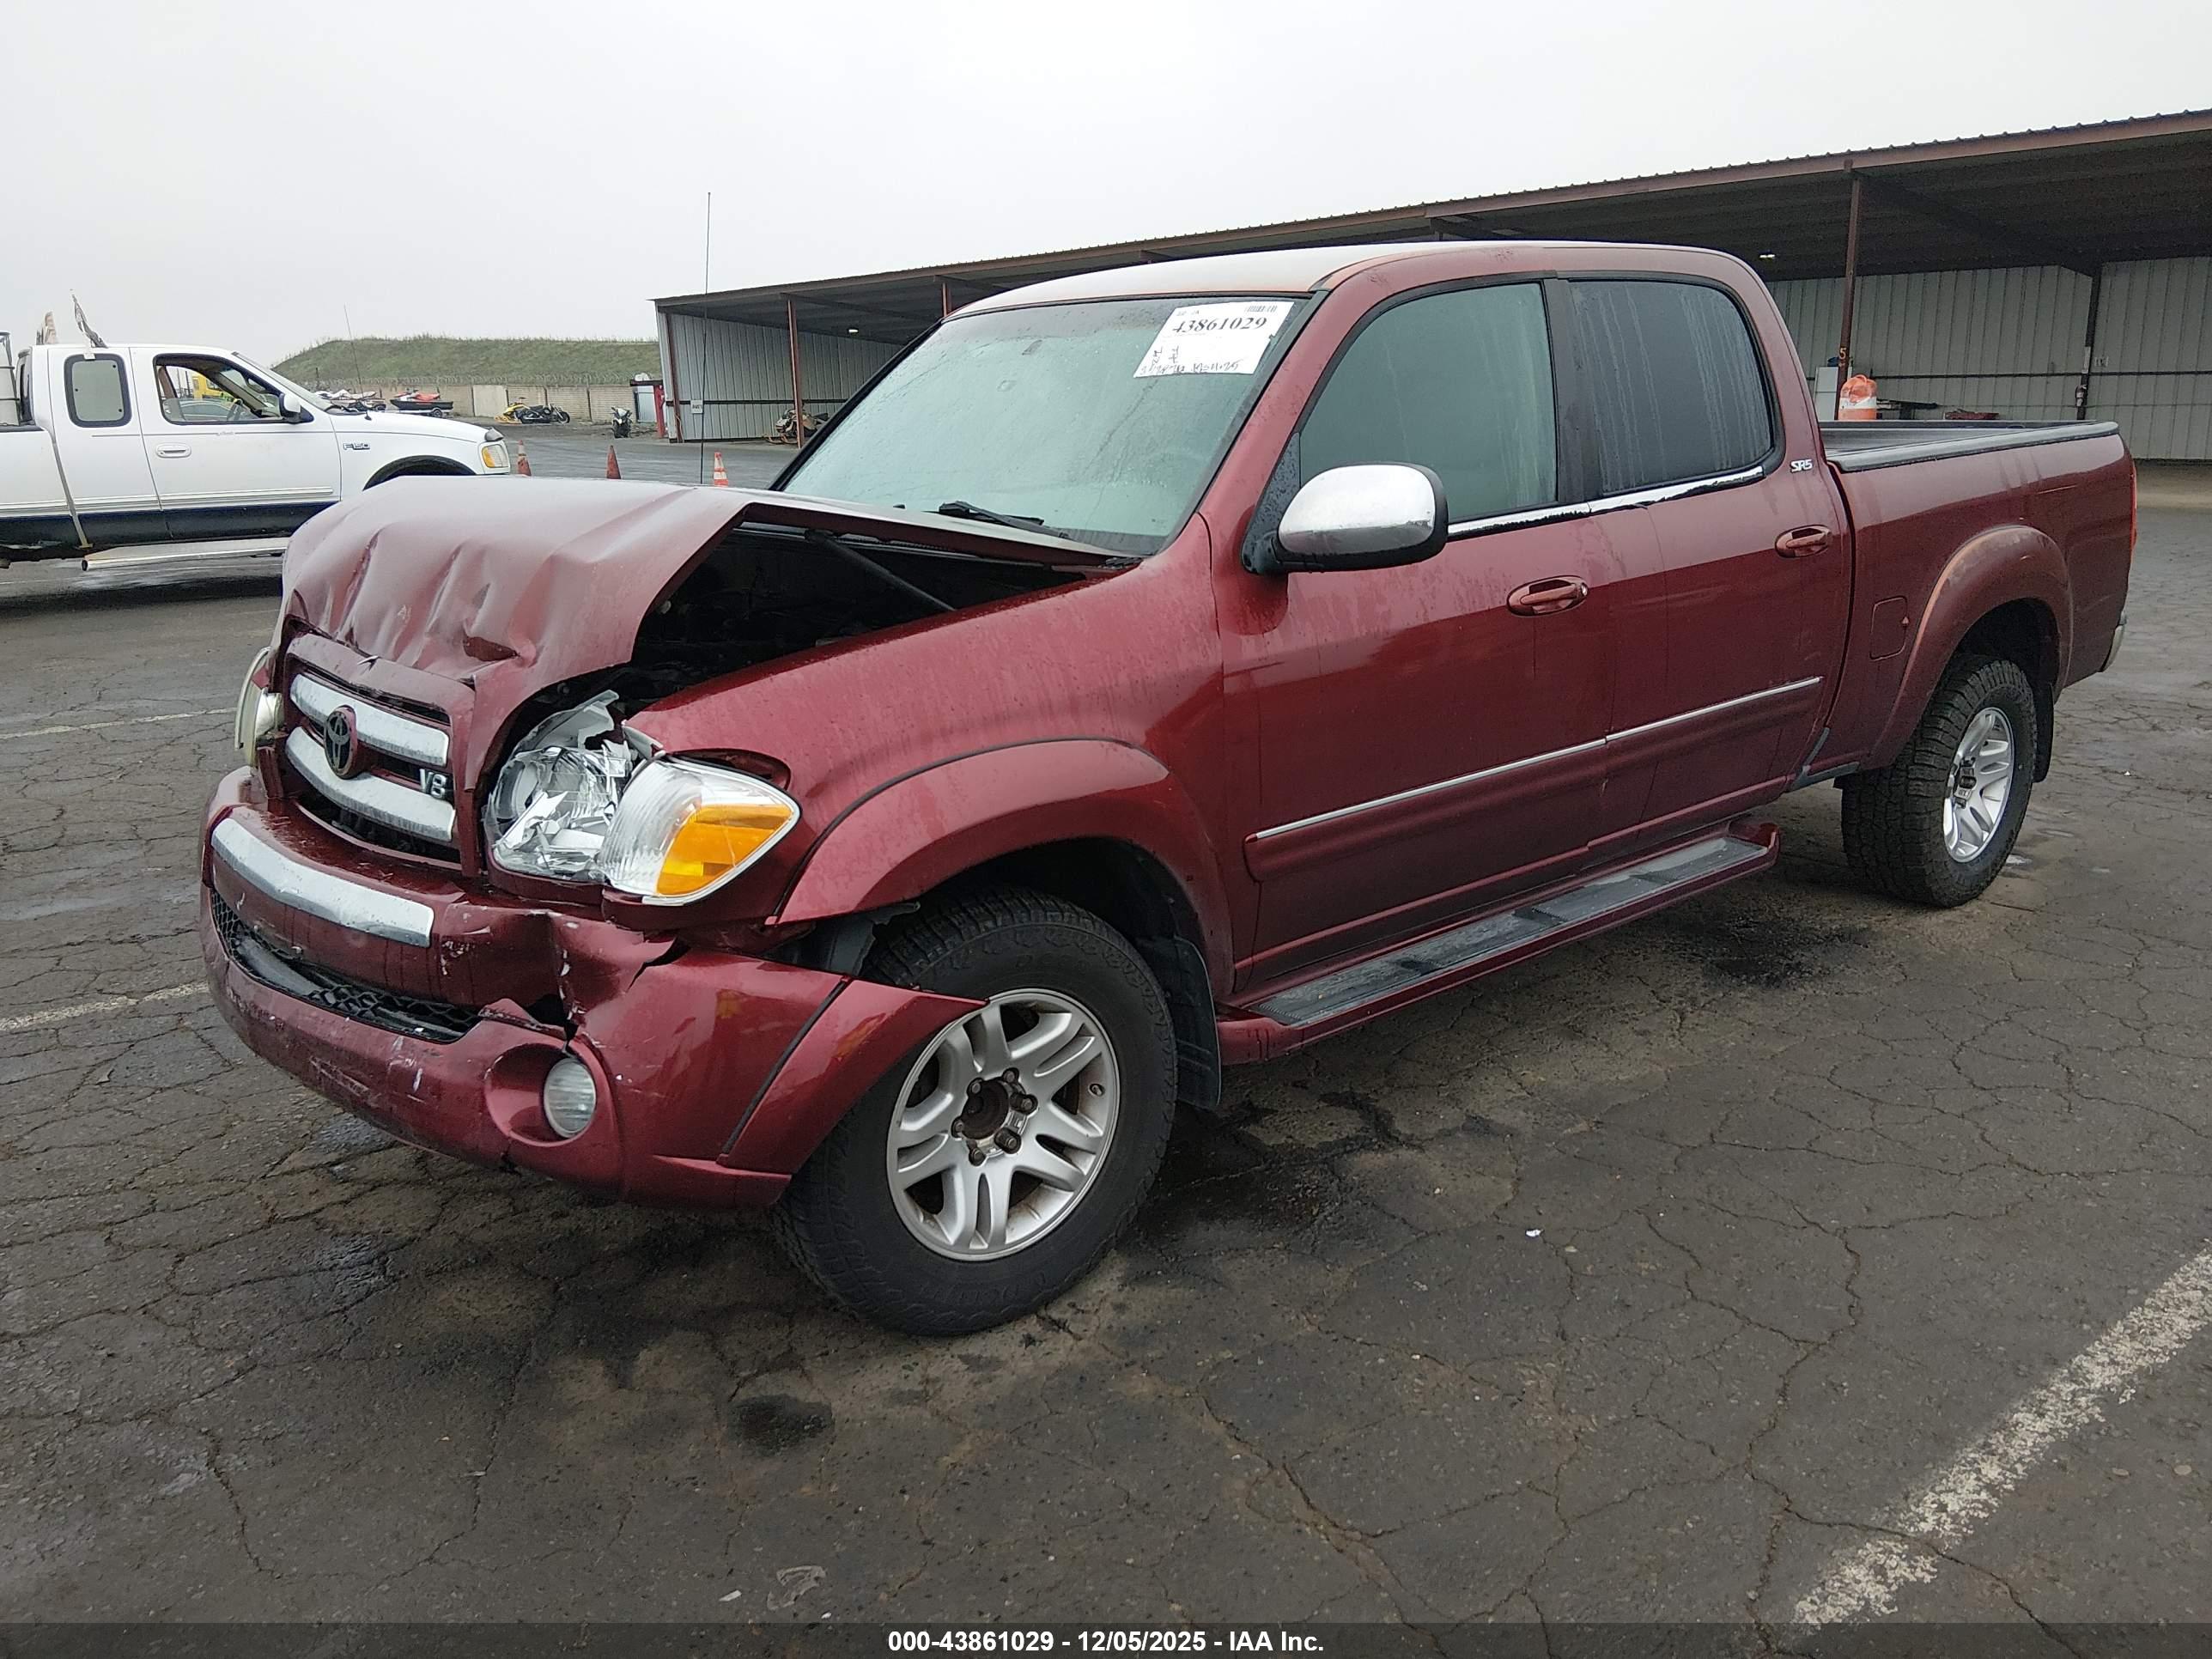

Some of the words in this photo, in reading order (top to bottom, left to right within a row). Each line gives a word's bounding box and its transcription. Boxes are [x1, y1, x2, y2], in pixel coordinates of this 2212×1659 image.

[1172, 317, 1267, 333] 43861029
[1838, 347, 1847, 360] 5
[1790, 459, 1813, 472] SR5
[419, 769, 447, 799] V8
